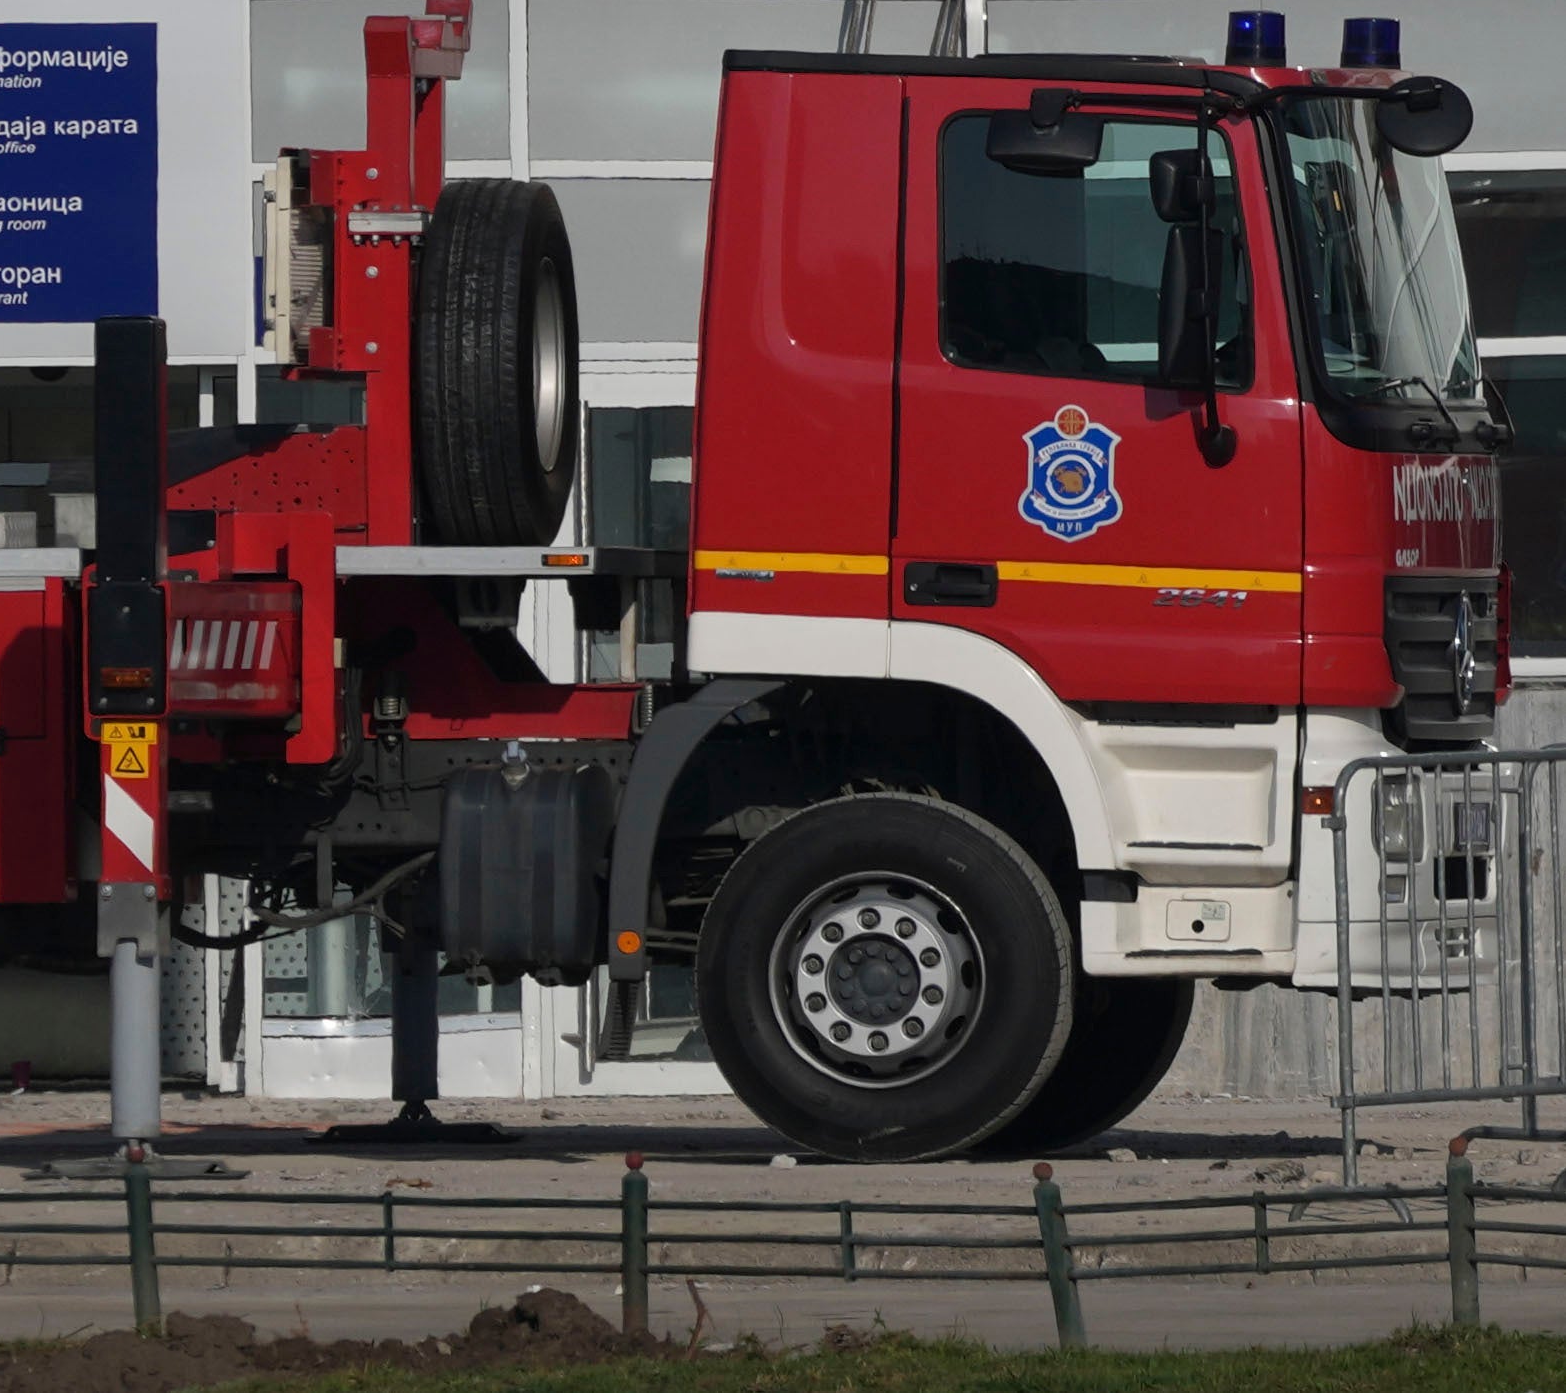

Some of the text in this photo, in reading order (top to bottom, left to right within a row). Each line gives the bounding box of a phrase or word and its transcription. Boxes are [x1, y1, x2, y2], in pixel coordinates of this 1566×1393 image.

[54, 119, 138, 138] карата
[7, 220, 46, 231] room
[1396, 549, 1419, 567] GASOP
[1153, 588, 1248, 607] 2641
